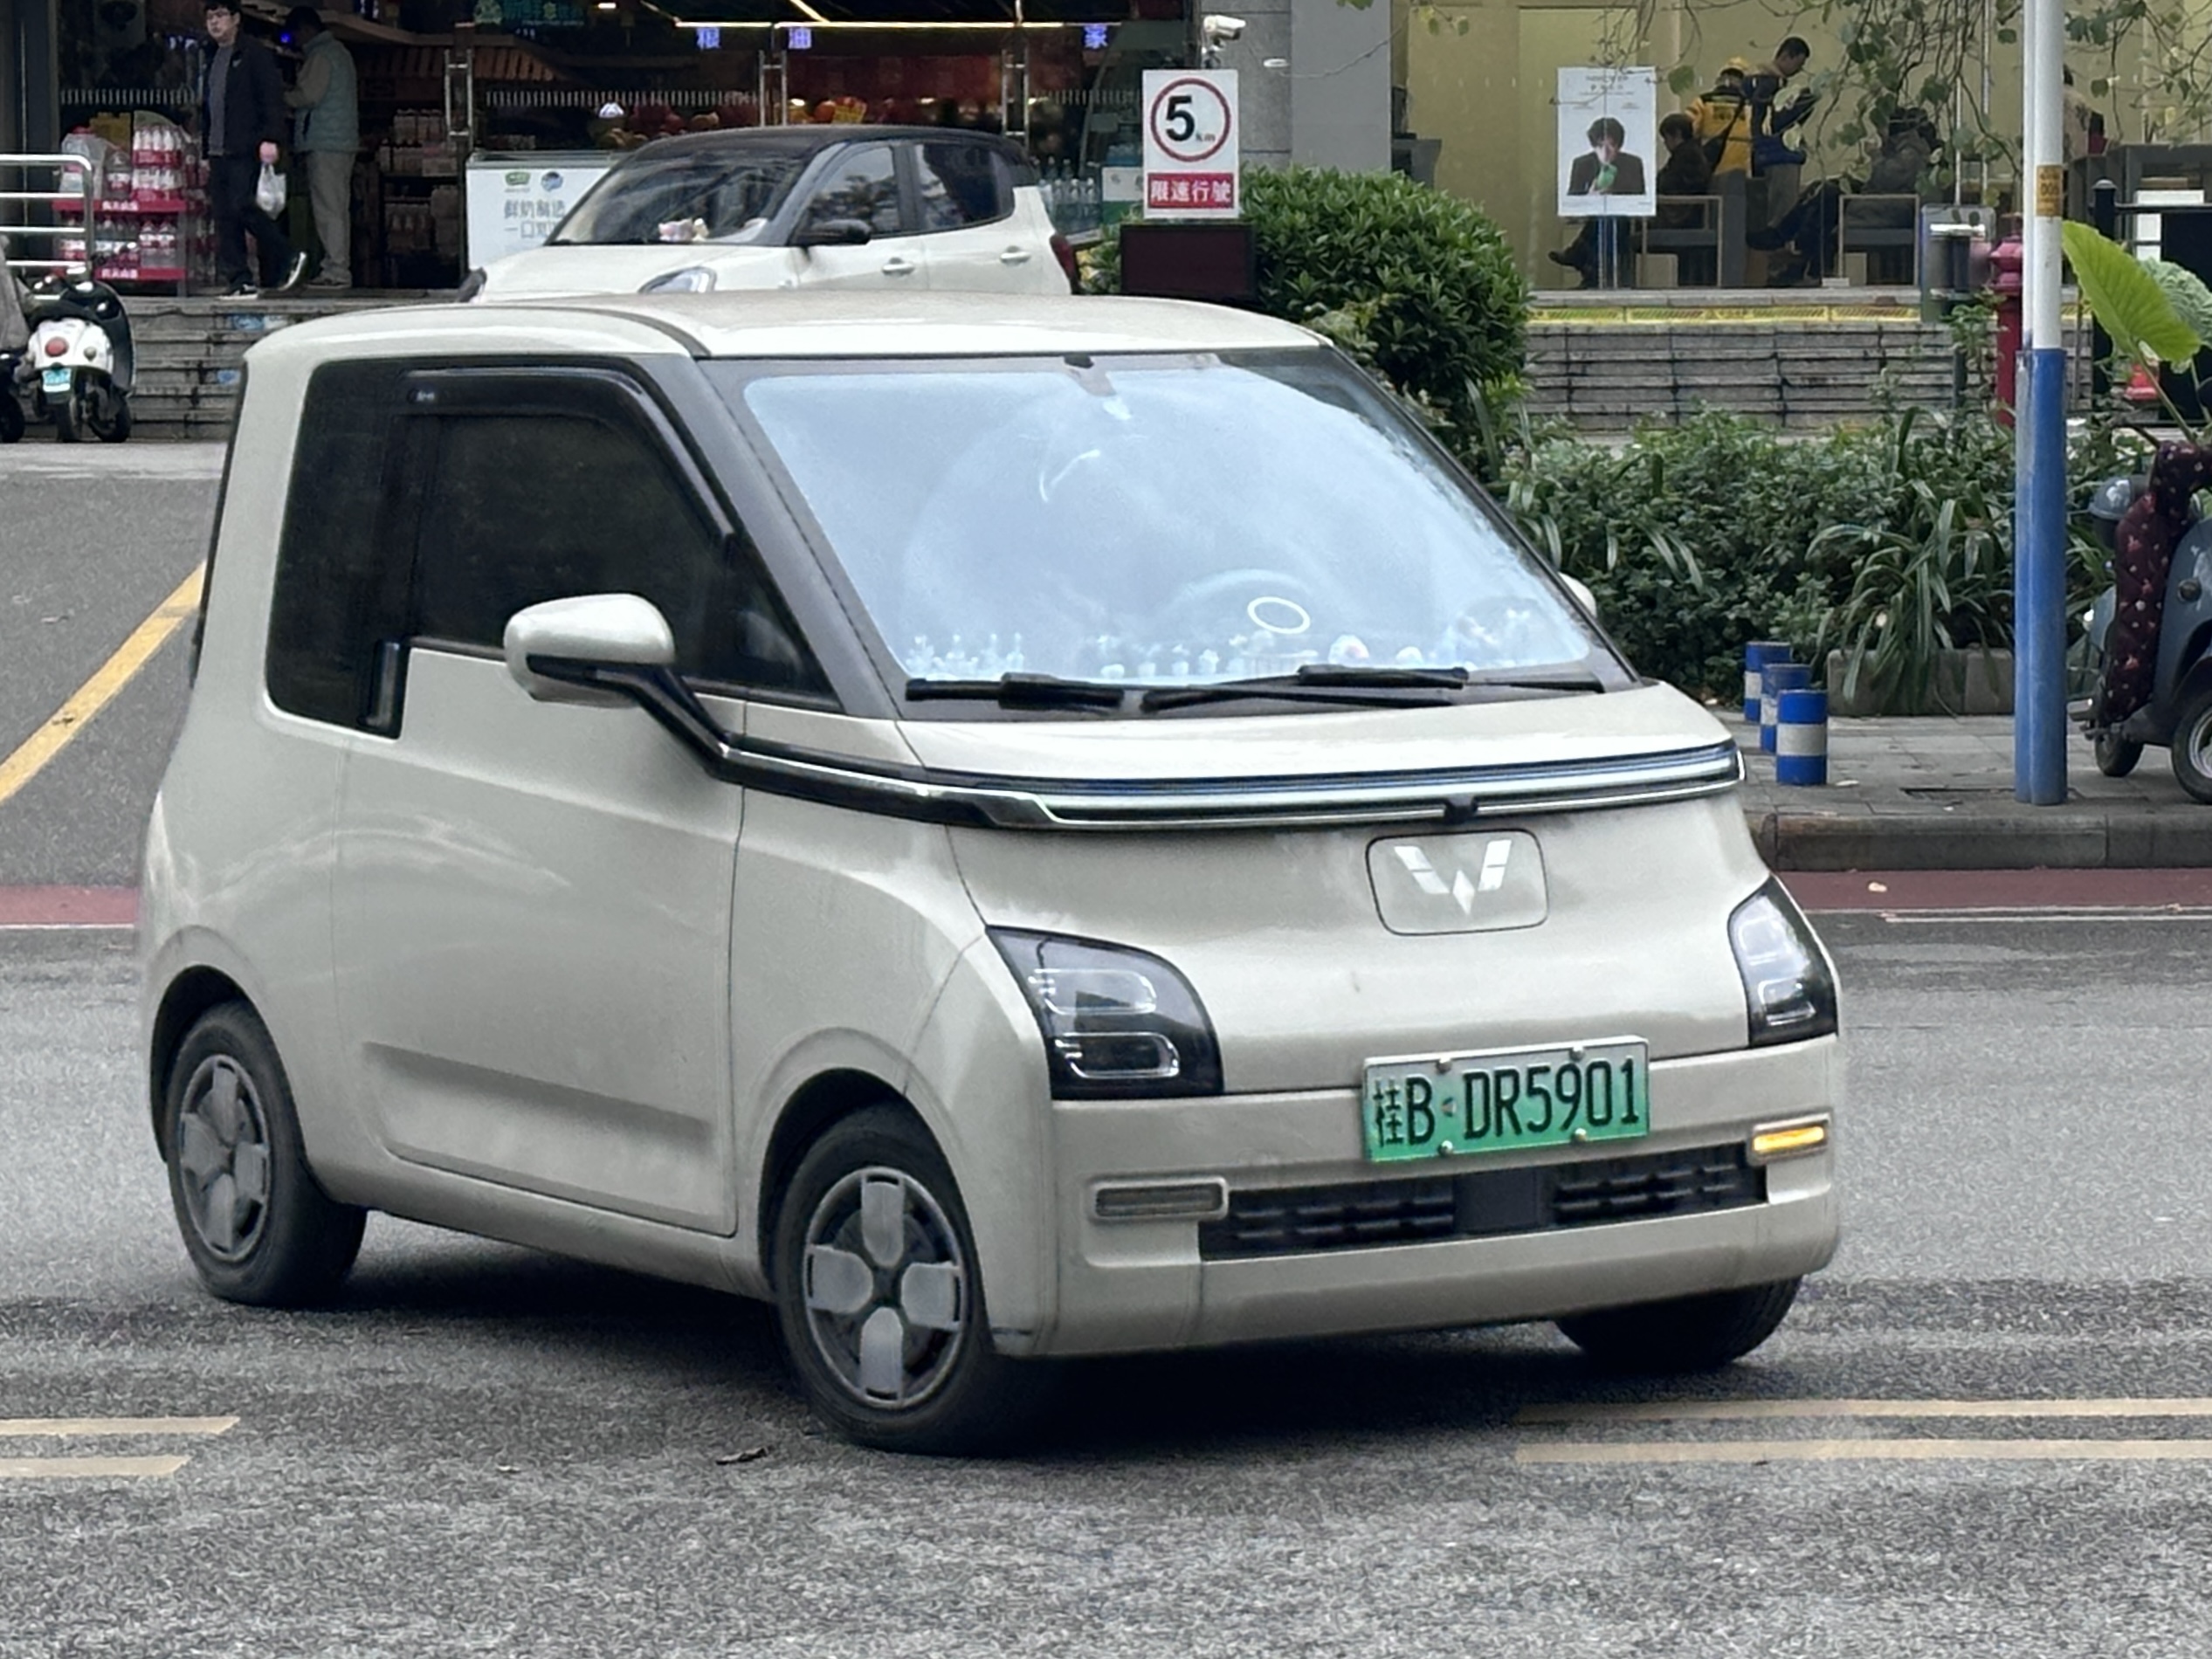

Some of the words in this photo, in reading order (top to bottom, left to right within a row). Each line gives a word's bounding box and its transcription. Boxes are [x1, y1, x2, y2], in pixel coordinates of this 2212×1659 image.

[789, 28, 811, 50] 油
[1166, 95, 1195, 141] 5
[1463, 1055, 1639, 1139] DR5901
